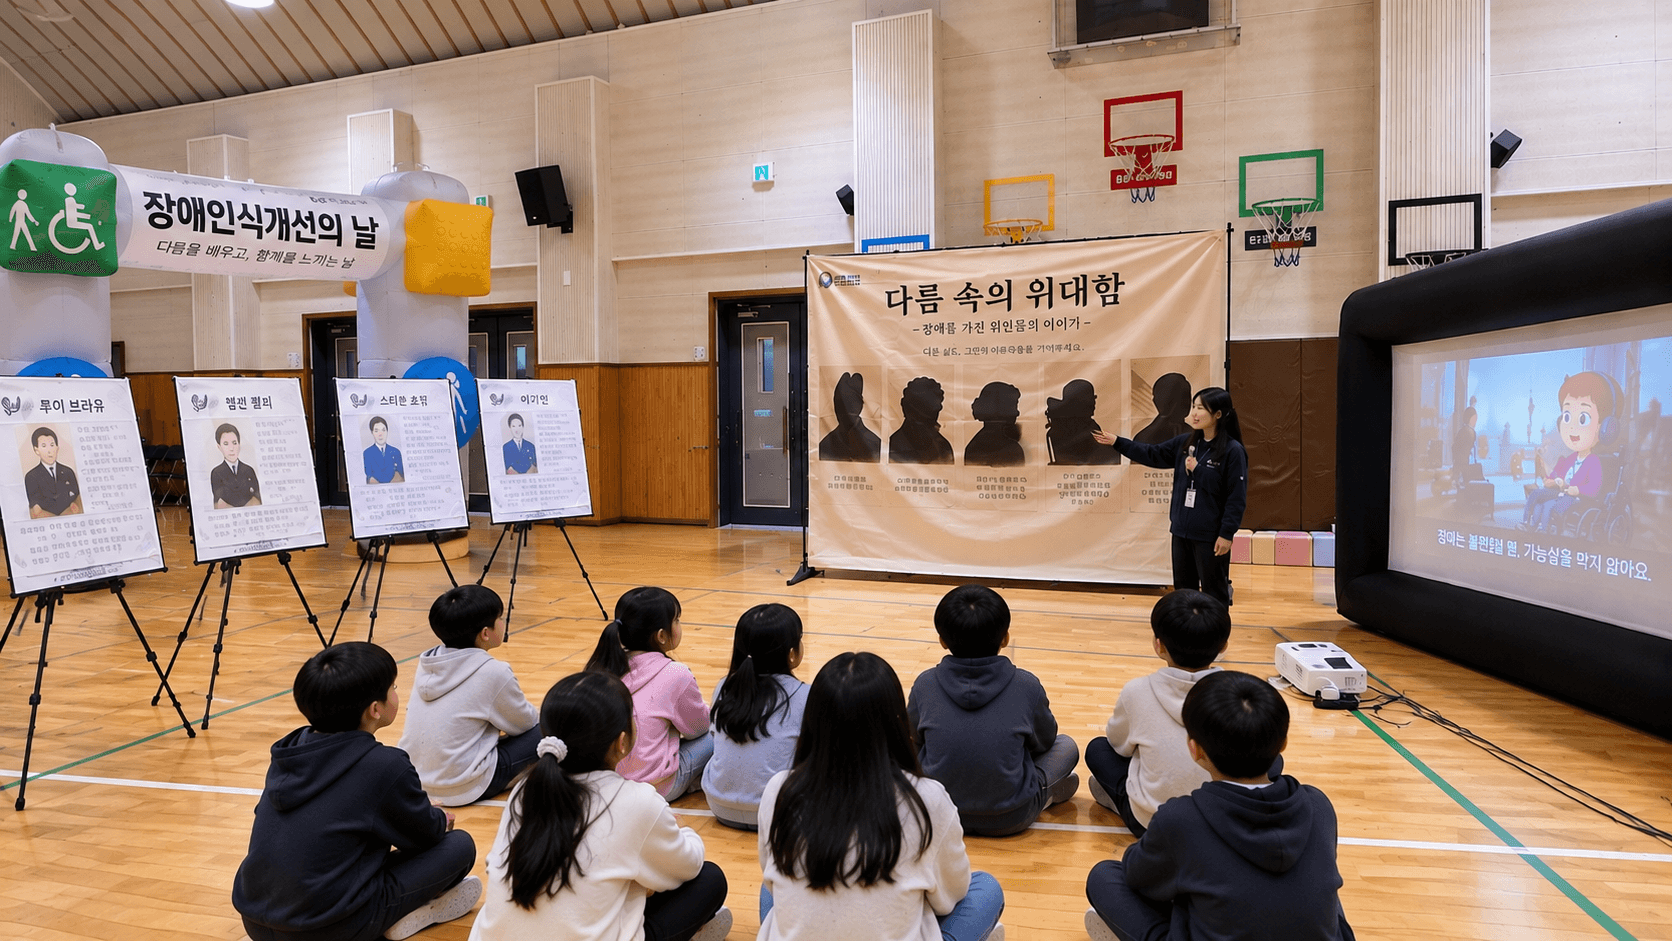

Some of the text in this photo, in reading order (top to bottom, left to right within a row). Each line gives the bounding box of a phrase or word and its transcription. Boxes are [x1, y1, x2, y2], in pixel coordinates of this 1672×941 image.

[143, 191, 379, 250] 장애인식개선의 날
[885, 272, 1126, 316] 다름 속의 위대함
[961, 321, 985, 335] 가진
[69, 398, 105, 413] 브라유
[1576, 552, 1601, 573] 막지
